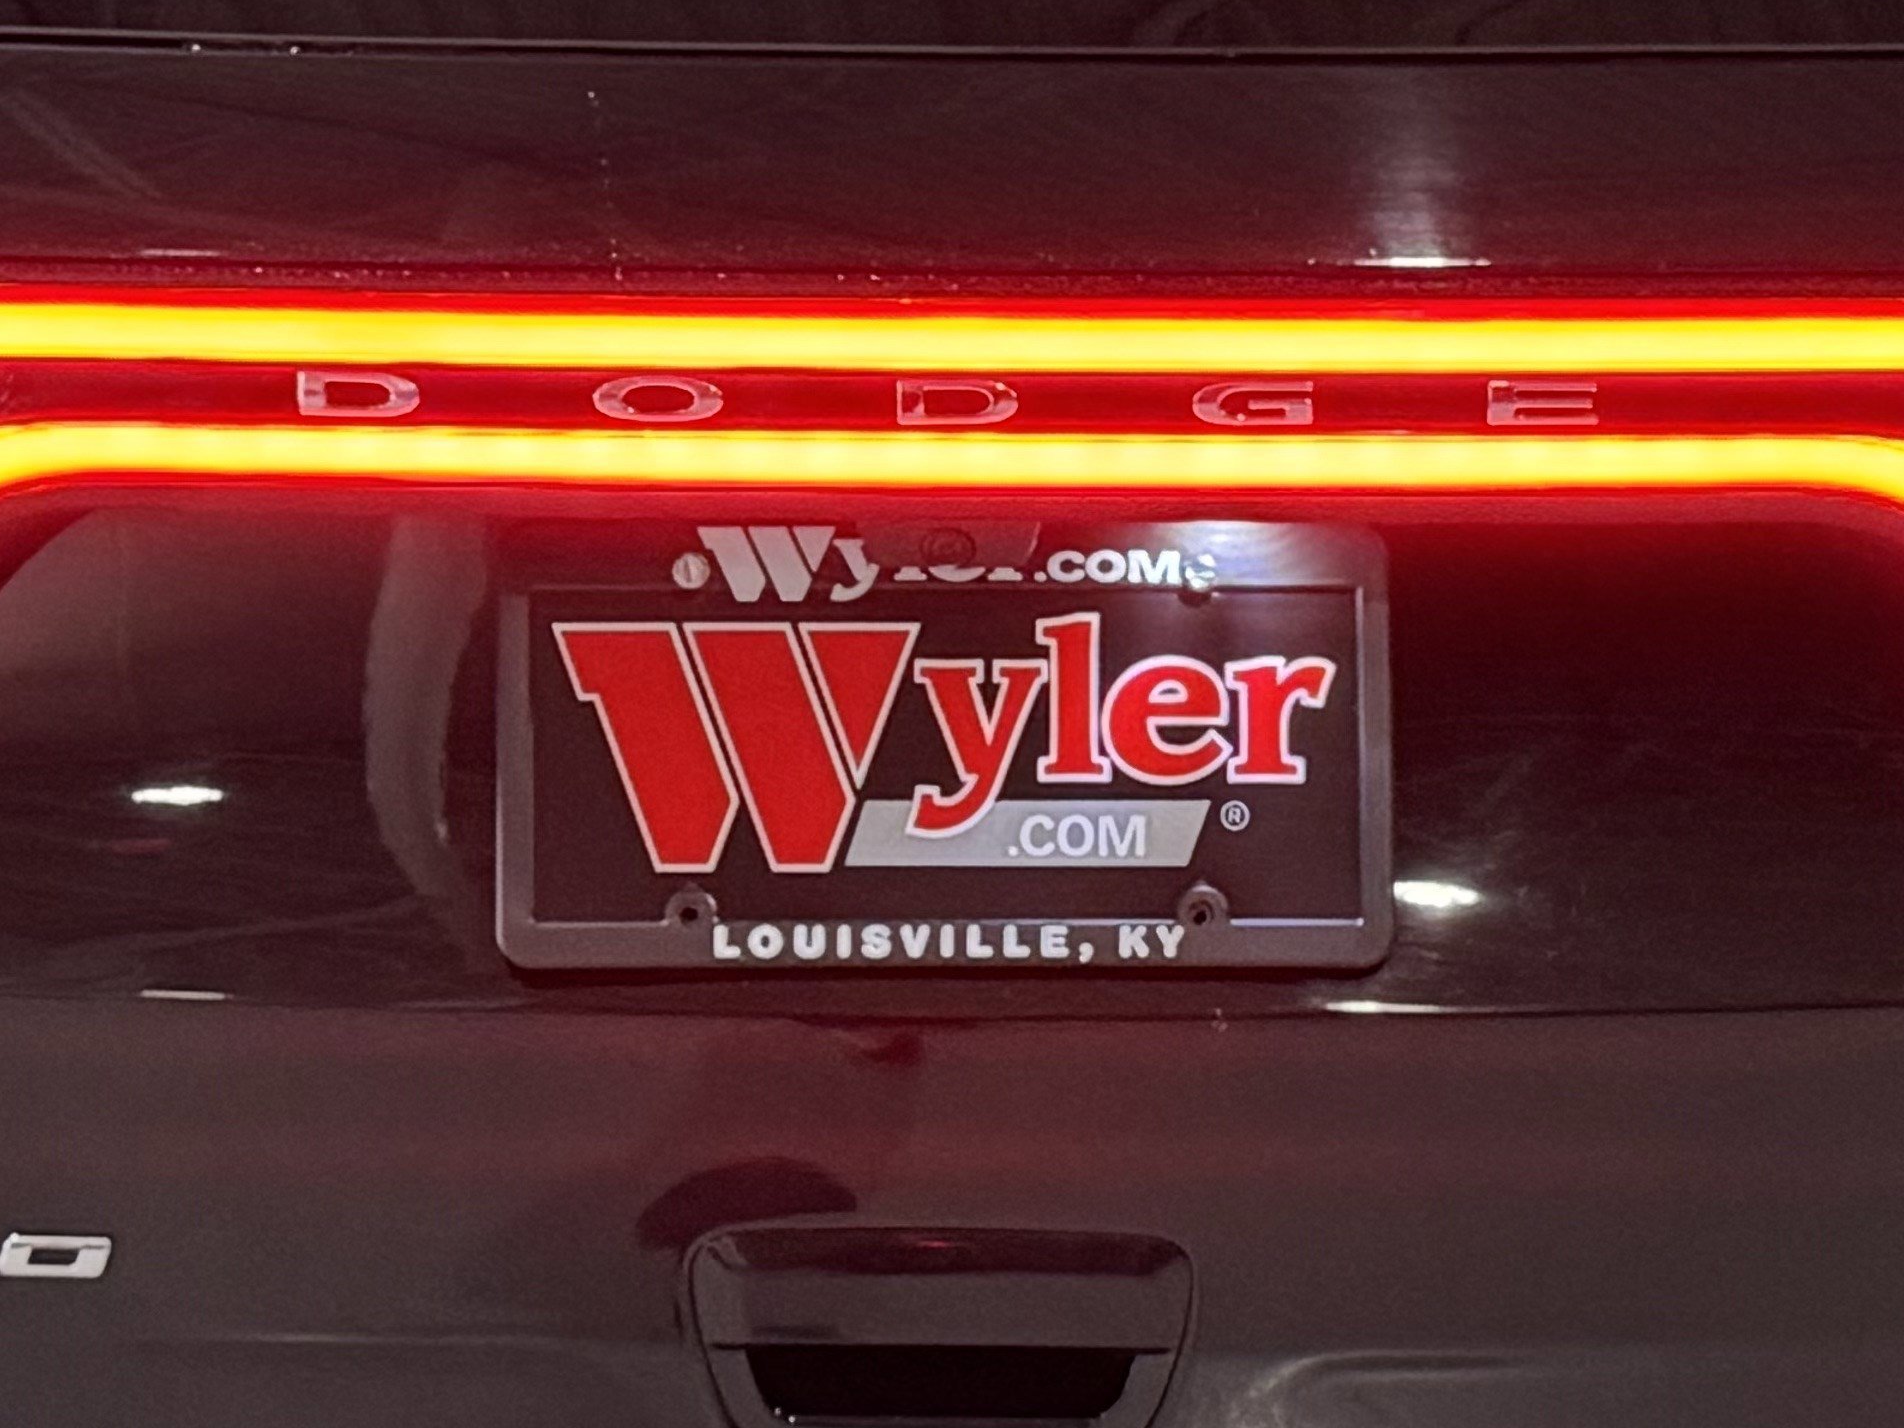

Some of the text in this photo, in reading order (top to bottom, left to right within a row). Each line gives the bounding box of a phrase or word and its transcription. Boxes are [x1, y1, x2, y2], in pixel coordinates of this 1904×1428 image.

[297, 371, 1599, 429] DODGE
[552, 612, 1337, 874] Wyler
[712, 923, 1186, 964] LOUISVILLE, KY
